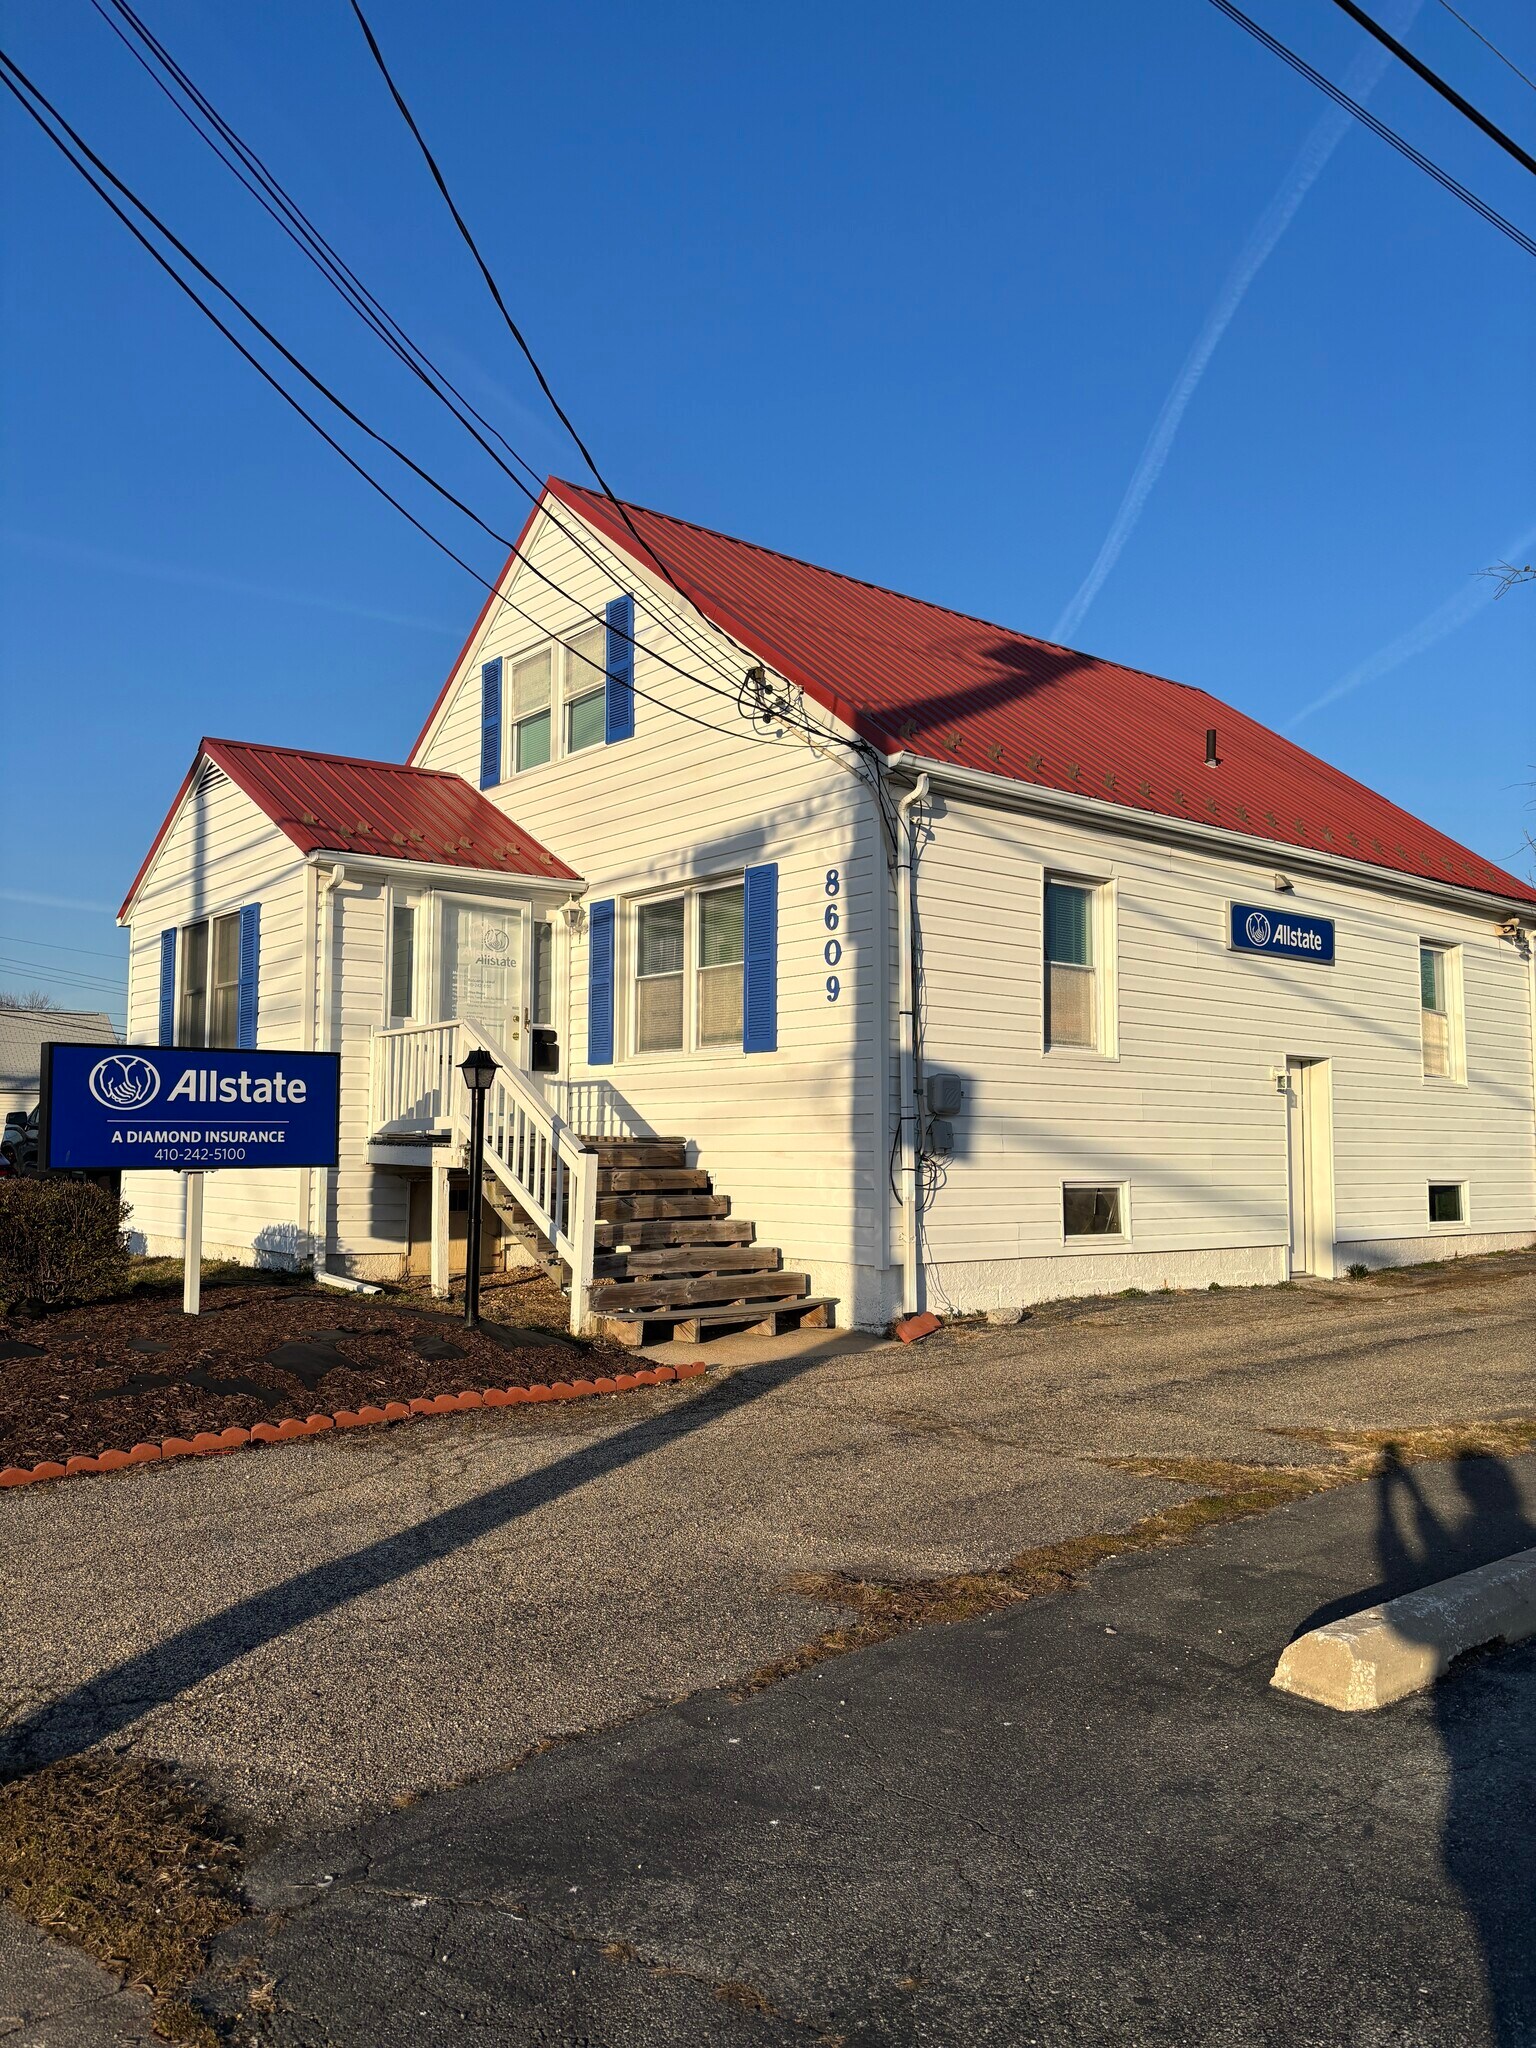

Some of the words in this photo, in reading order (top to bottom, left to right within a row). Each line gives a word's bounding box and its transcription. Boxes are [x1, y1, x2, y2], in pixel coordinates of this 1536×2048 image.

[824, 869, 842, 1002] 8609
[1272, 924, 1322, 951] Allstate
[475, 954, 517, 968] Allstate
[167, 1069, 307, 1104] Allstate
[111, 1130, 123, 1143] A
[127, 1130, 201, 1143] DIAMOND
[205, 1130, 285, 1143] INSURANCE
[154, 1148, 246, 1161] 410-242-5100
